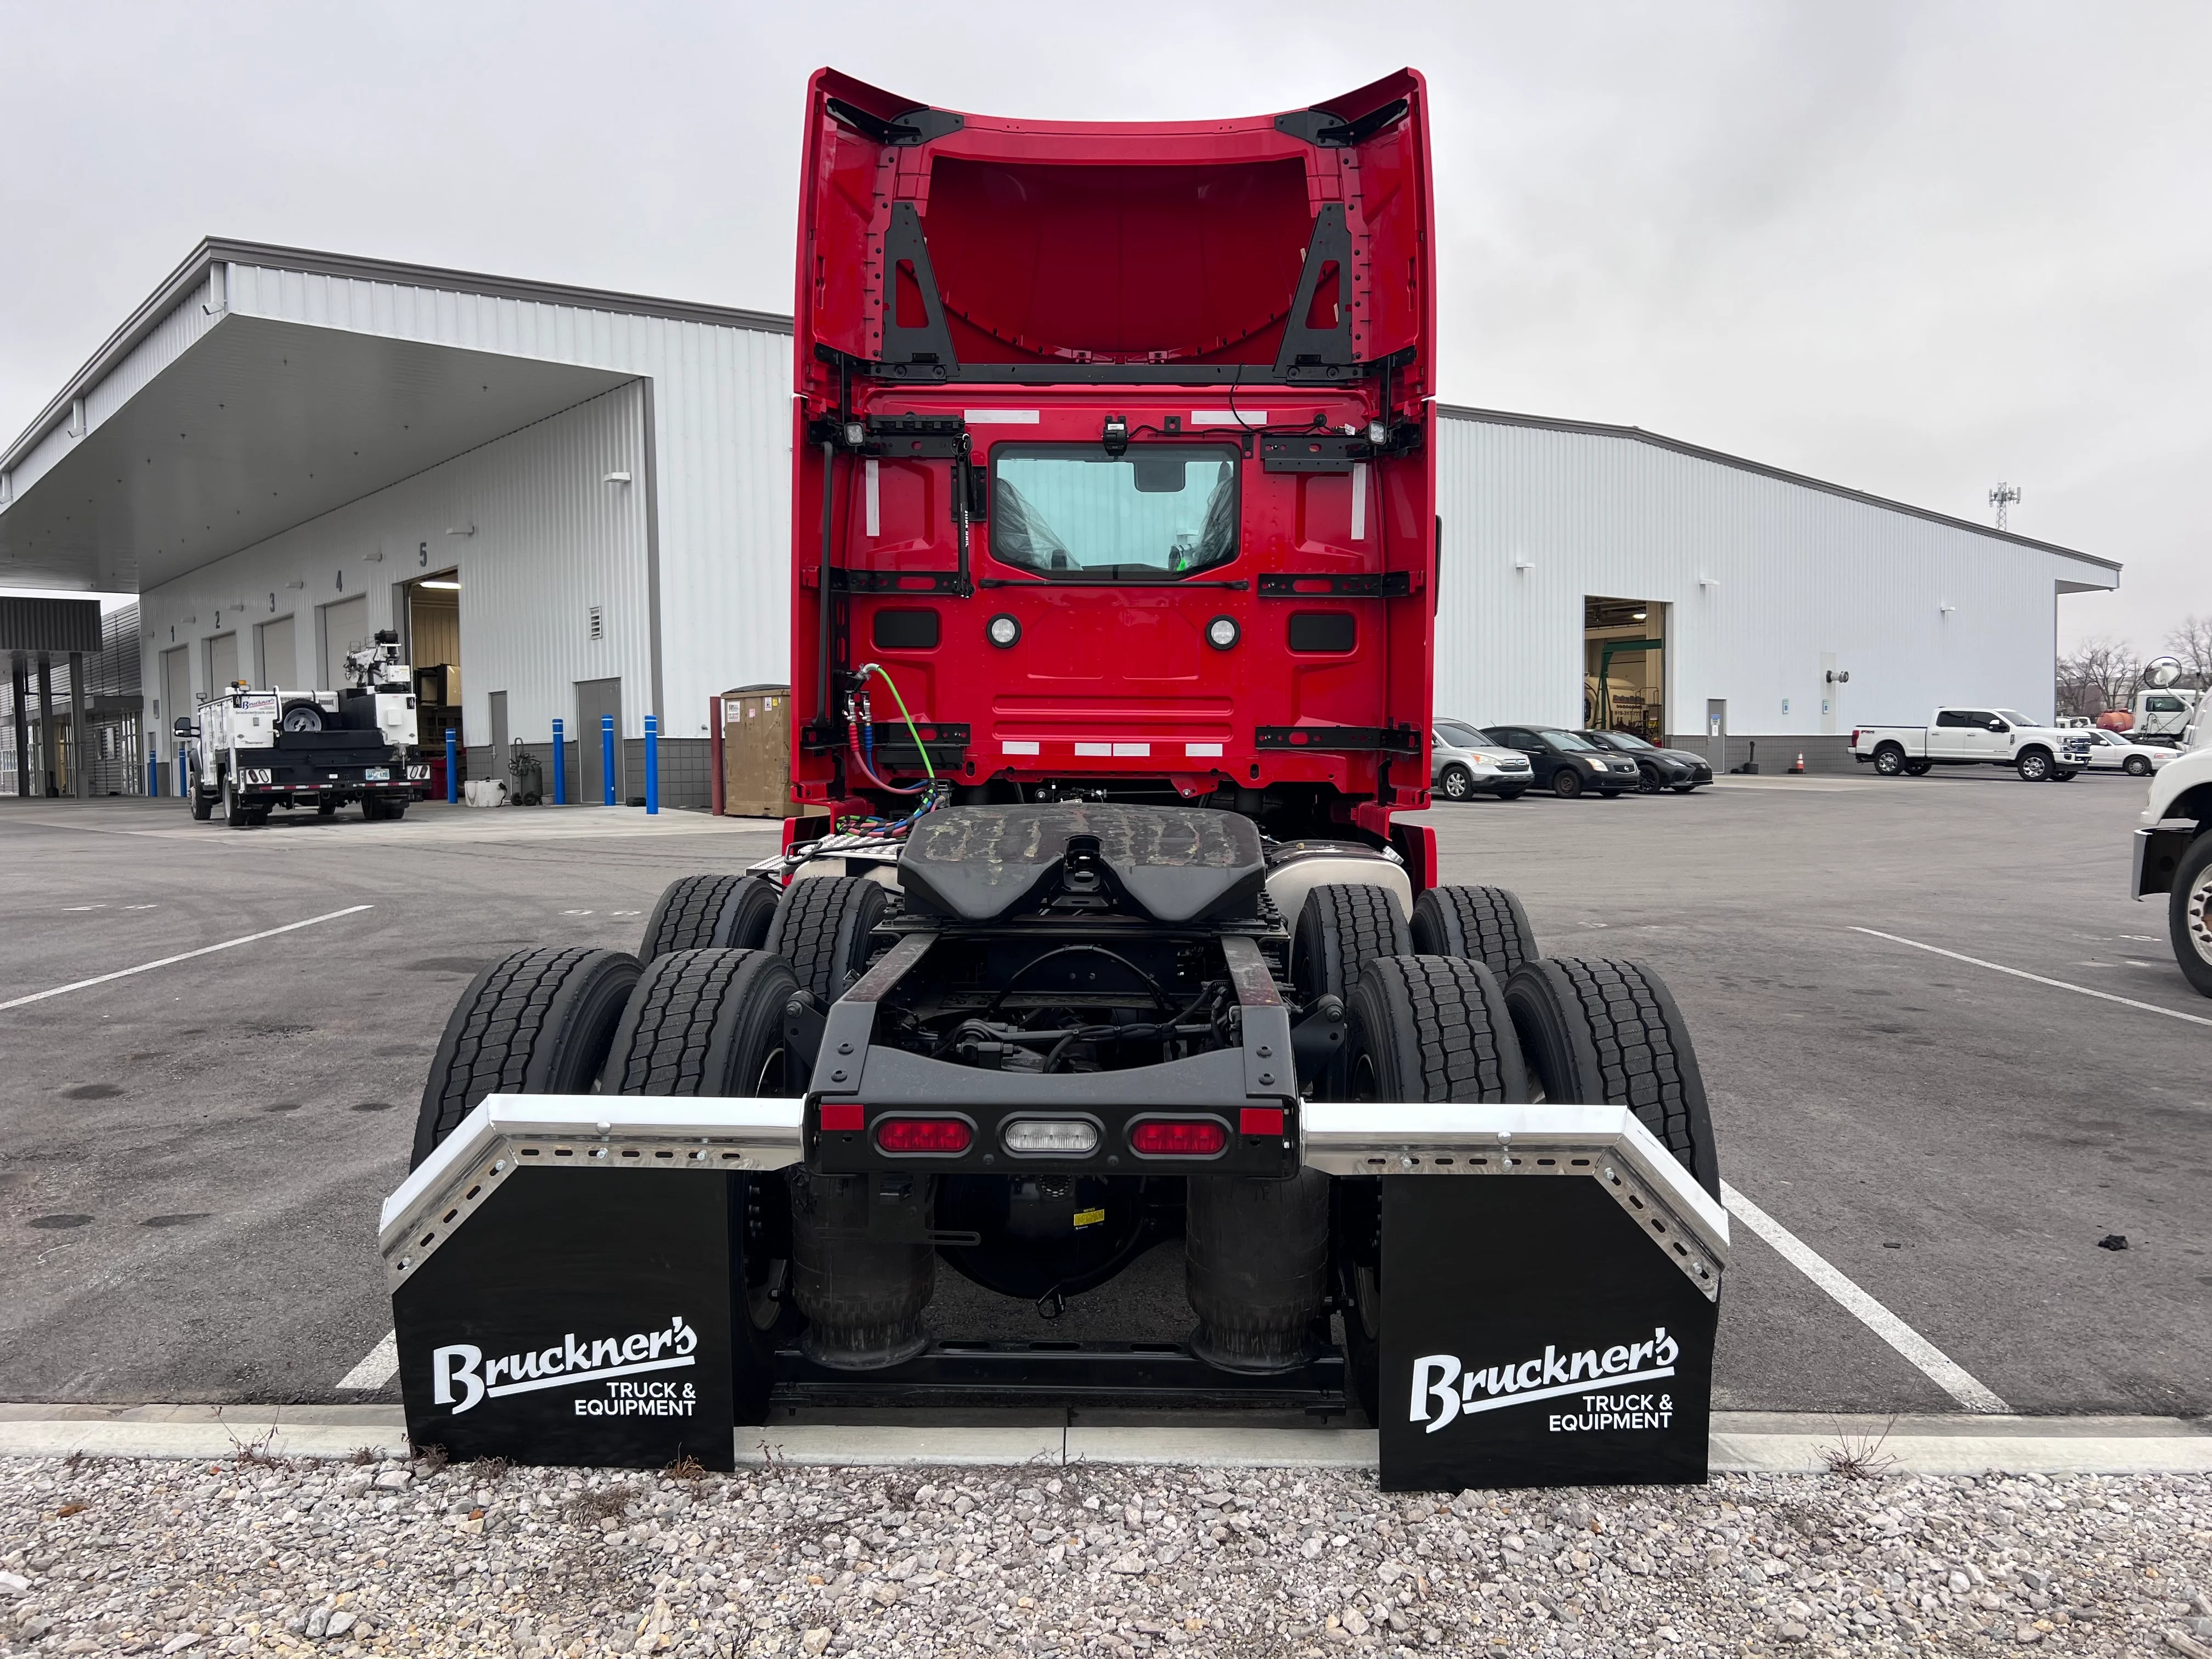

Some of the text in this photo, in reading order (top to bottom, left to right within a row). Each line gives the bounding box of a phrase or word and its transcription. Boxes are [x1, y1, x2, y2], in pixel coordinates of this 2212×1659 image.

[420, 542, 427, 567] 5
[336, 570, 343, 592] 4
[269, 592, 275, 612] 3
[215, 611, 221, 629] 2
[171, 625, 174, 642] 1
[433, 1316, 697, 1415] Bruckner's
[607, 1382, 696, 1398] TRUCK &
[1409, 1327, 1679, 1434] Bruckner's
[575, 1400, 697, 1416] EQUIPMENT
[1583, 1394, 1673, 1412] TRUCK &
[1549, 1412, 1673, 1432] EQUIPMENT
